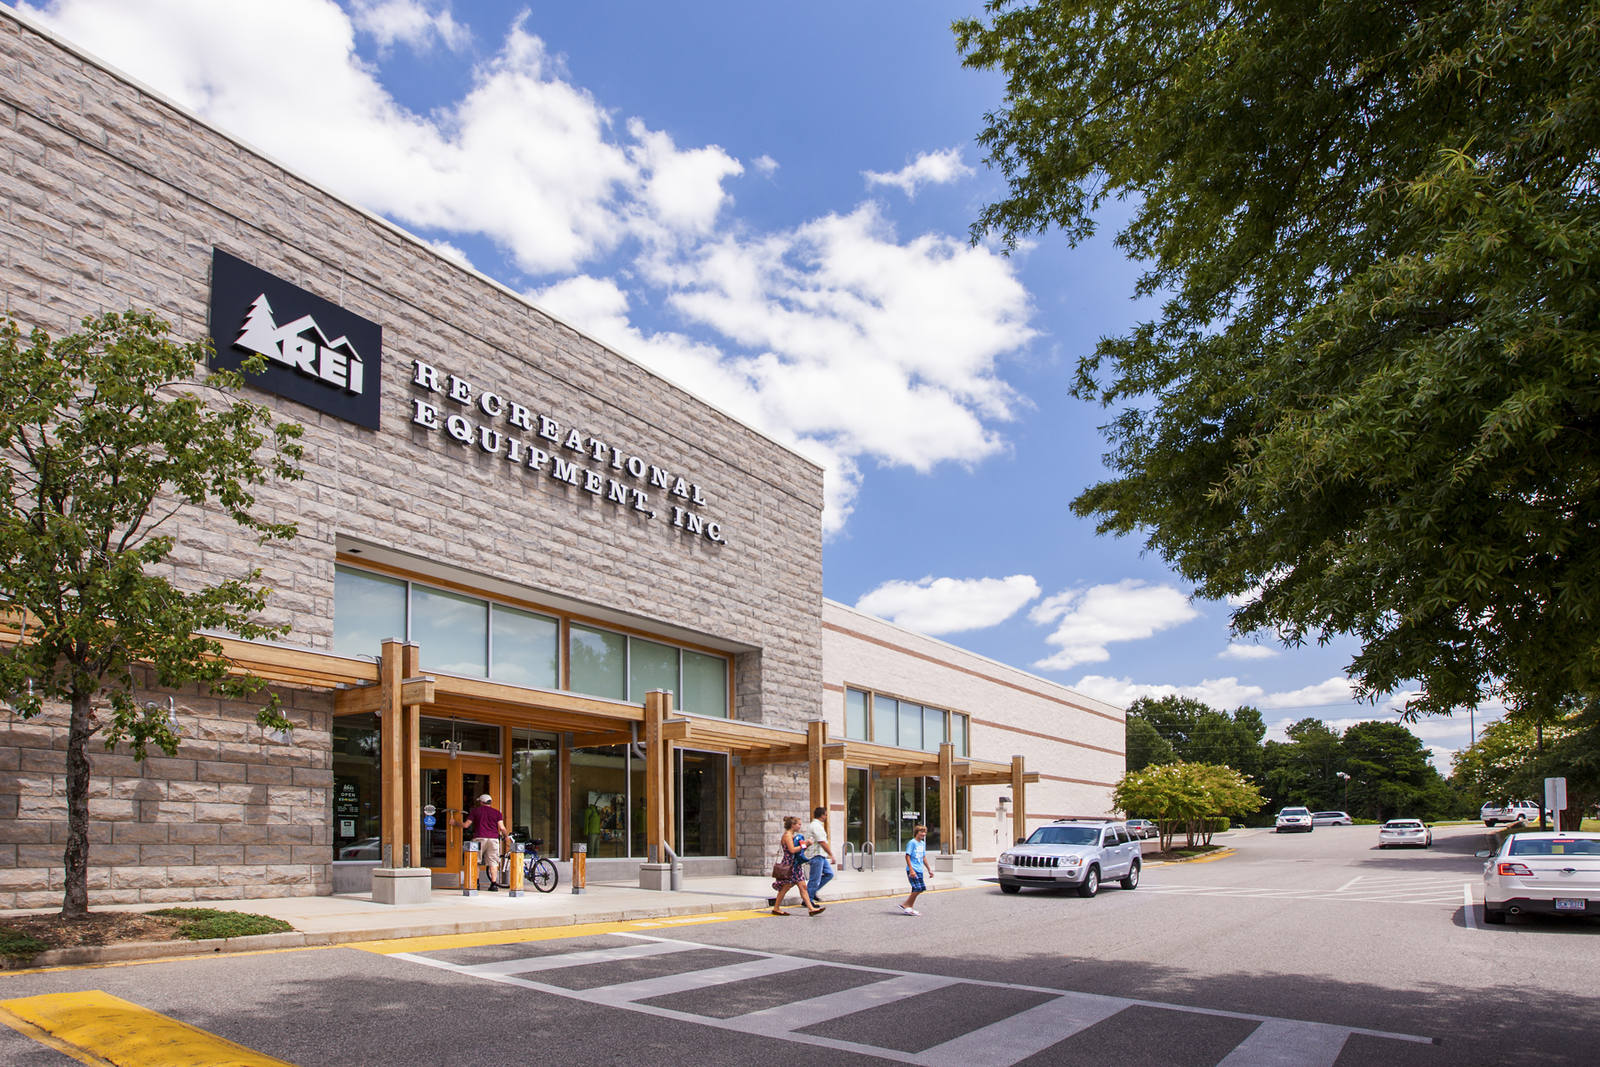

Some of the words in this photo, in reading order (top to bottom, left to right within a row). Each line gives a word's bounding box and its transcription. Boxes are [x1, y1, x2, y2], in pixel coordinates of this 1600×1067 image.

[281, 330, 364, 394] REI
[412, 359, 707, 506] RECREATIONAL
[412, 398, 658, 519] EQUIPMENT,
[672, 506, 728, 545] INC.
